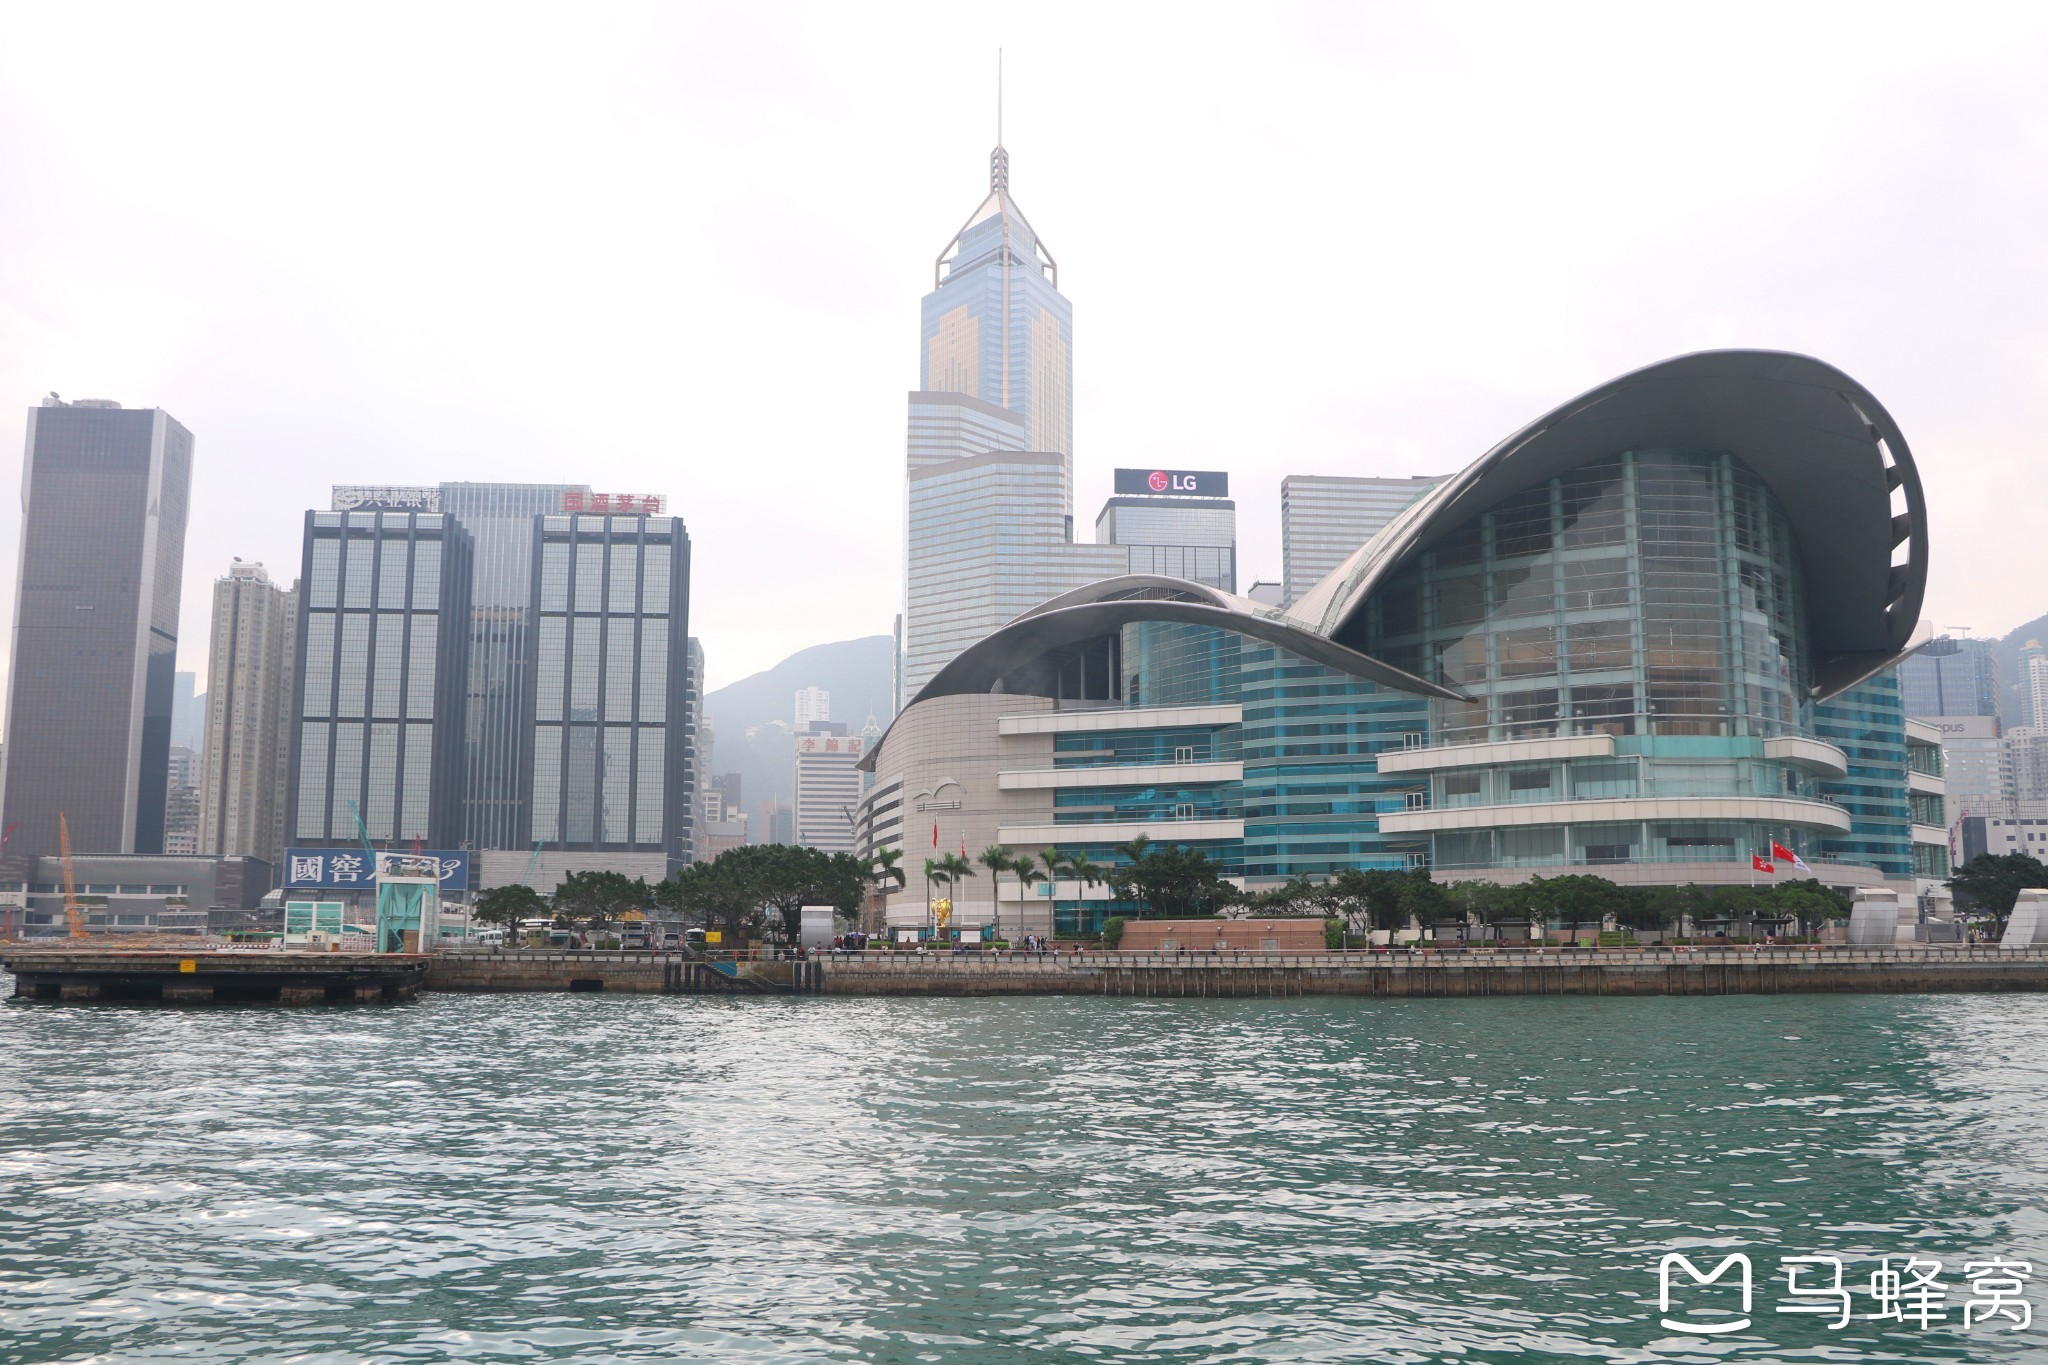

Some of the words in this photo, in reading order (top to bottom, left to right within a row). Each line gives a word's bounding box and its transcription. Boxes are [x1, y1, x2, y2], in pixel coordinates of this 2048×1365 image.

[1173, 475, 1197, 490] LG
[565, 493, 660, 513] 国酒茅台
